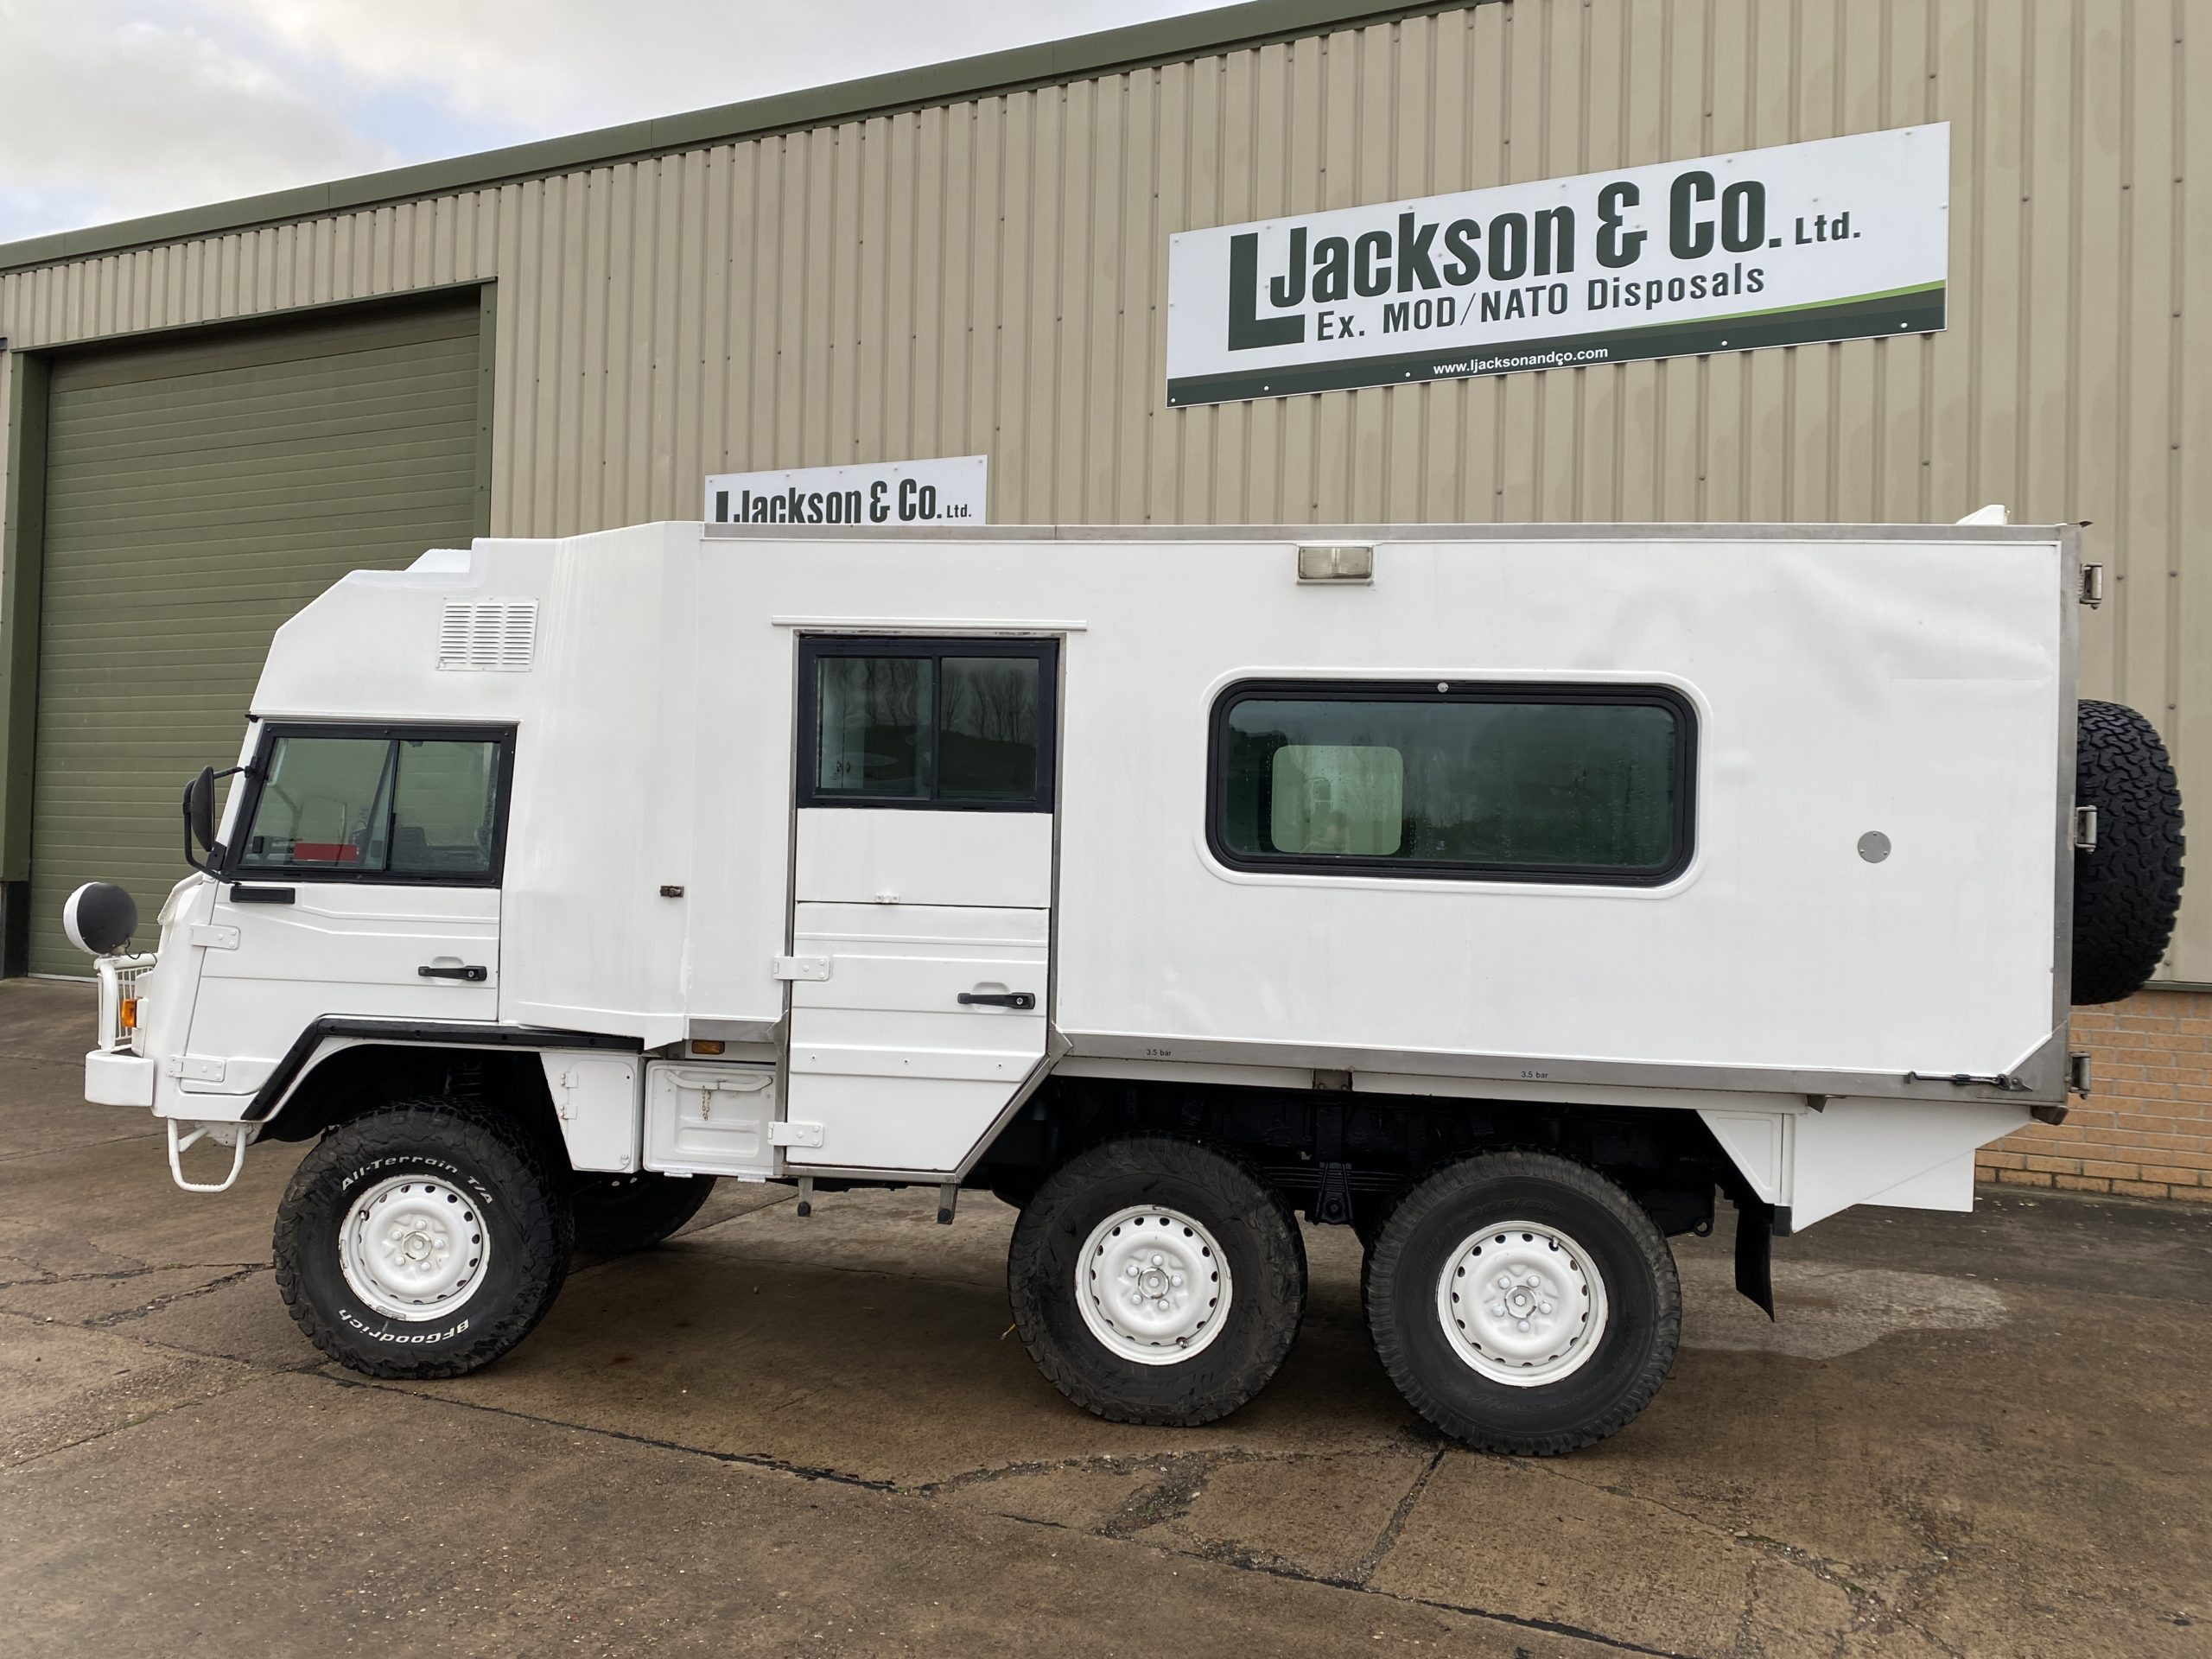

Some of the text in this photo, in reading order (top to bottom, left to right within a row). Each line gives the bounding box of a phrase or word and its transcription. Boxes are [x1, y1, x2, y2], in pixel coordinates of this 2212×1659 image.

[1596, 181, 1649, 269] &
[1669, 170, 1783, 260] Co.
[1795, 211, 1862, 245] Ltd.
[1317, 262, 1765, 341] Ex. MOD/NATO Disposals
[1433, 347, 1609, 374] www.ljacksonandco.com
[869, 480, 891, 524] &
[898, 478, 943, 522] Co.
[946, 503, 973, 519] Ltd.
[1160, 1048, 1173, 1057] bar
[1521, 1071, 1548, 1079] 3.5 bar
[342, 1155, 494, 1205] All-Terrain T/A
[338, 1308, 470, 1344] BFGoodrich
